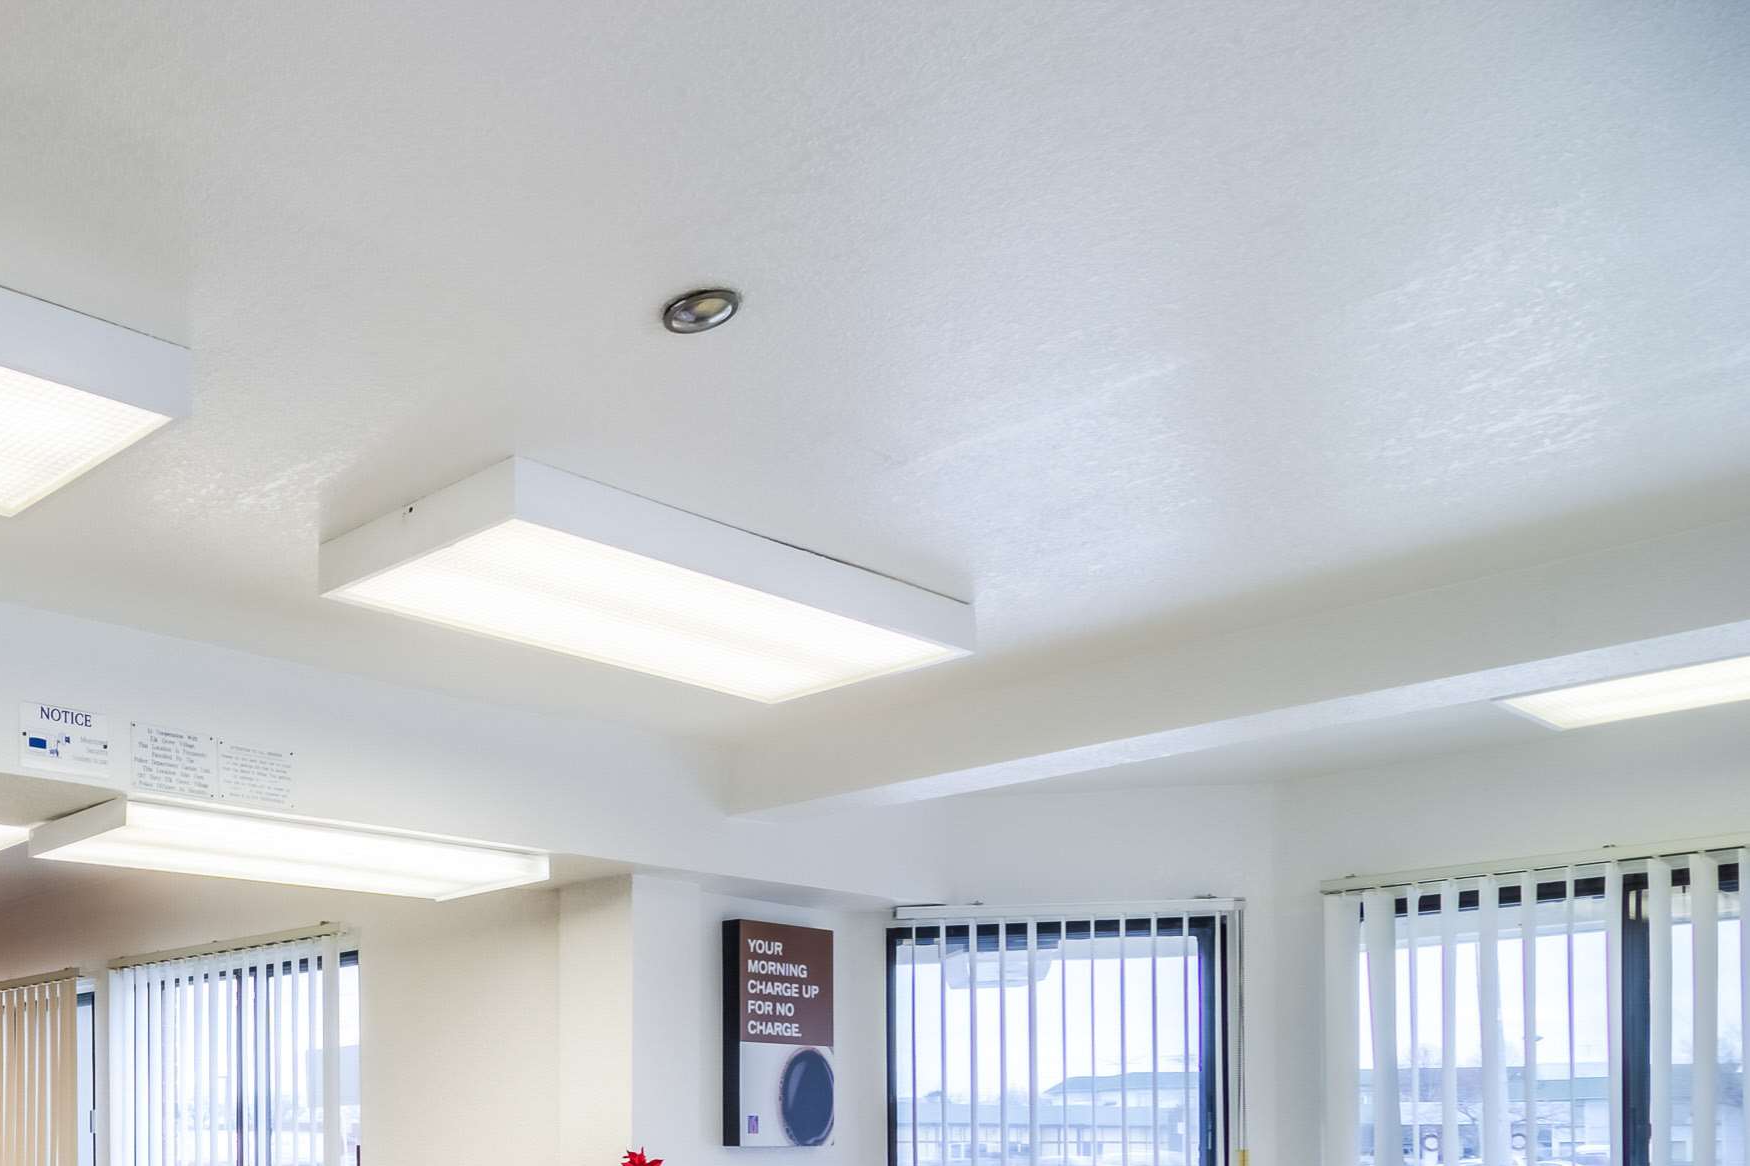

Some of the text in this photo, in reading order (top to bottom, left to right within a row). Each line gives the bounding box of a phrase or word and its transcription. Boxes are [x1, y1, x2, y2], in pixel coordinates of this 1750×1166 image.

[40, 706, 92, 728] NOTICE
[747, 938, 783, 956] YOUR
[747, 959, 808, 979] MORNING
[747, 979, 820, 999] CHARGE UP
[747, 1000, 795, 1018] FOR NO
[747, 1020, 802, 1037] CHARGE.
